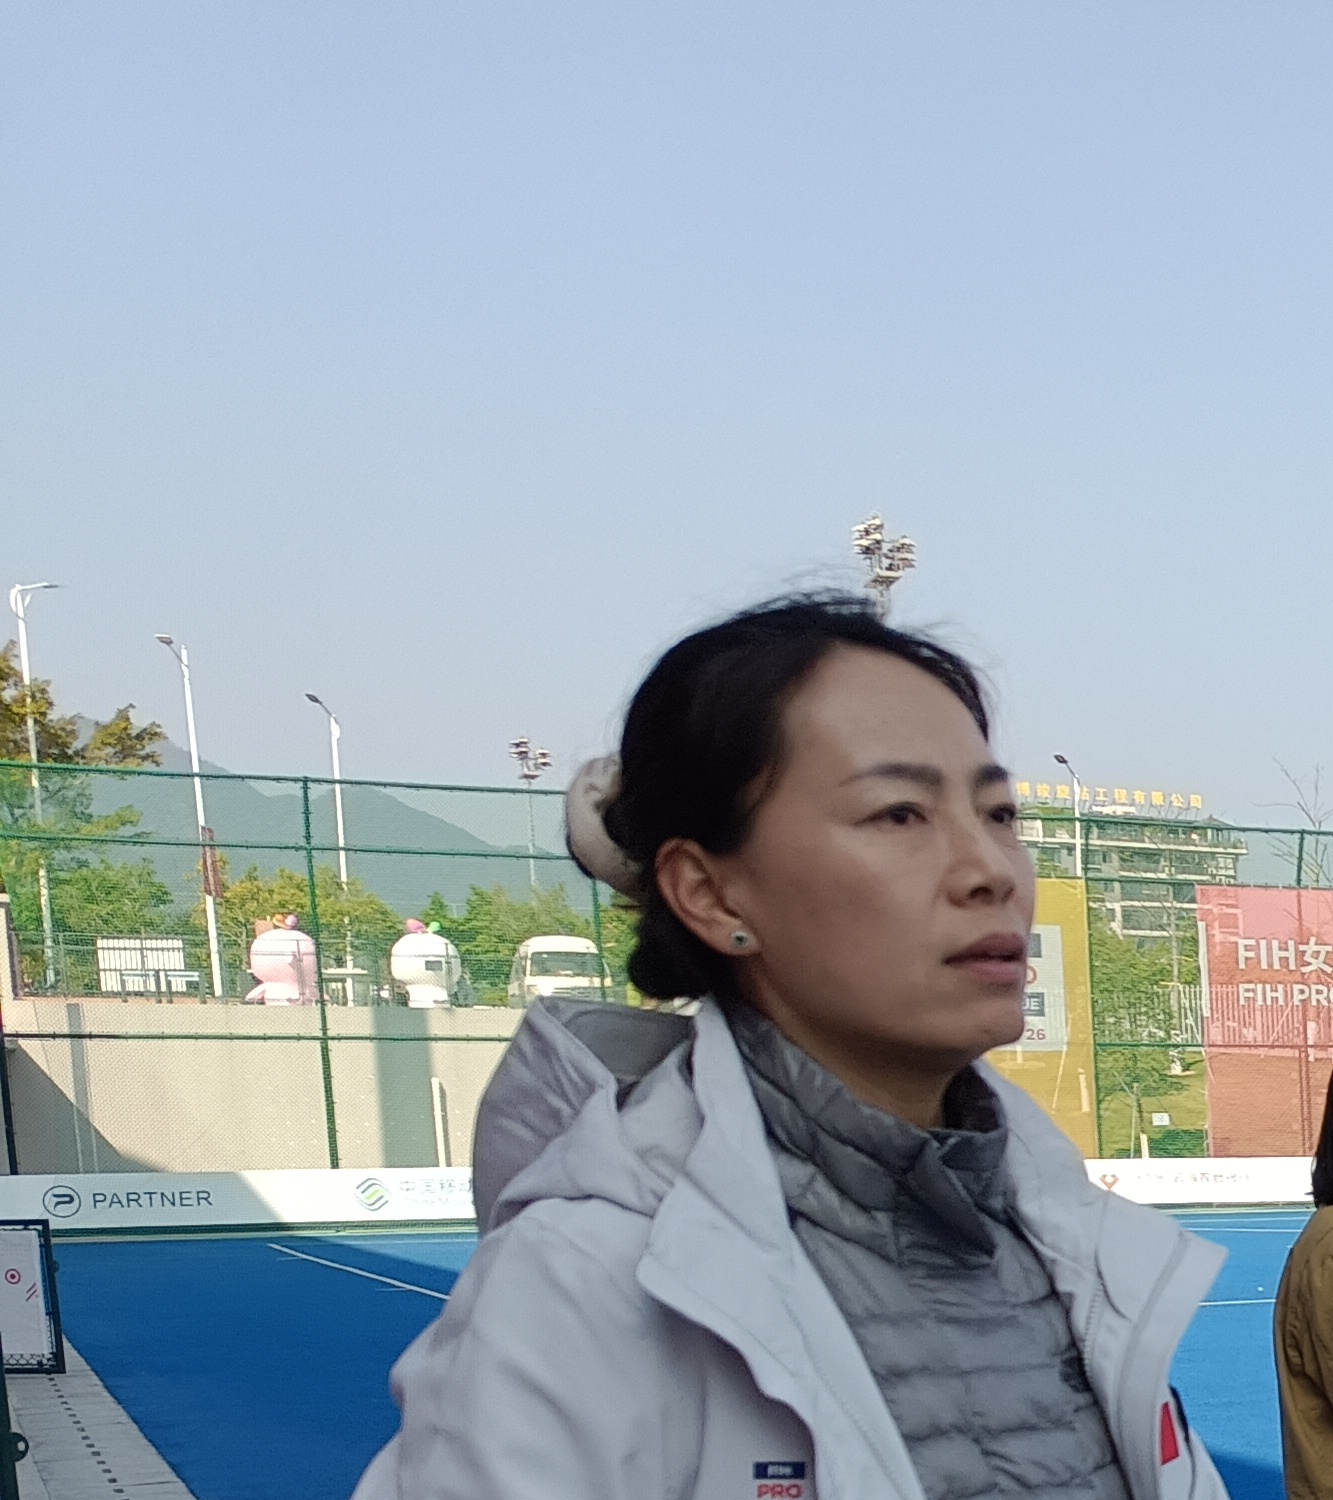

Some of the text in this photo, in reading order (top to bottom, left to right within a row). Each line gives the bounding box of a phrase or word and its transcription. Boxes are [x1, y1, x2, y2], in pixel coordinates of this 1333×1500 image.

[1239, 982, 1285, 1006] FIH
[92, 1189, 214, 1209] PARTNER
[757, 1483, 803, 1499] PRO
